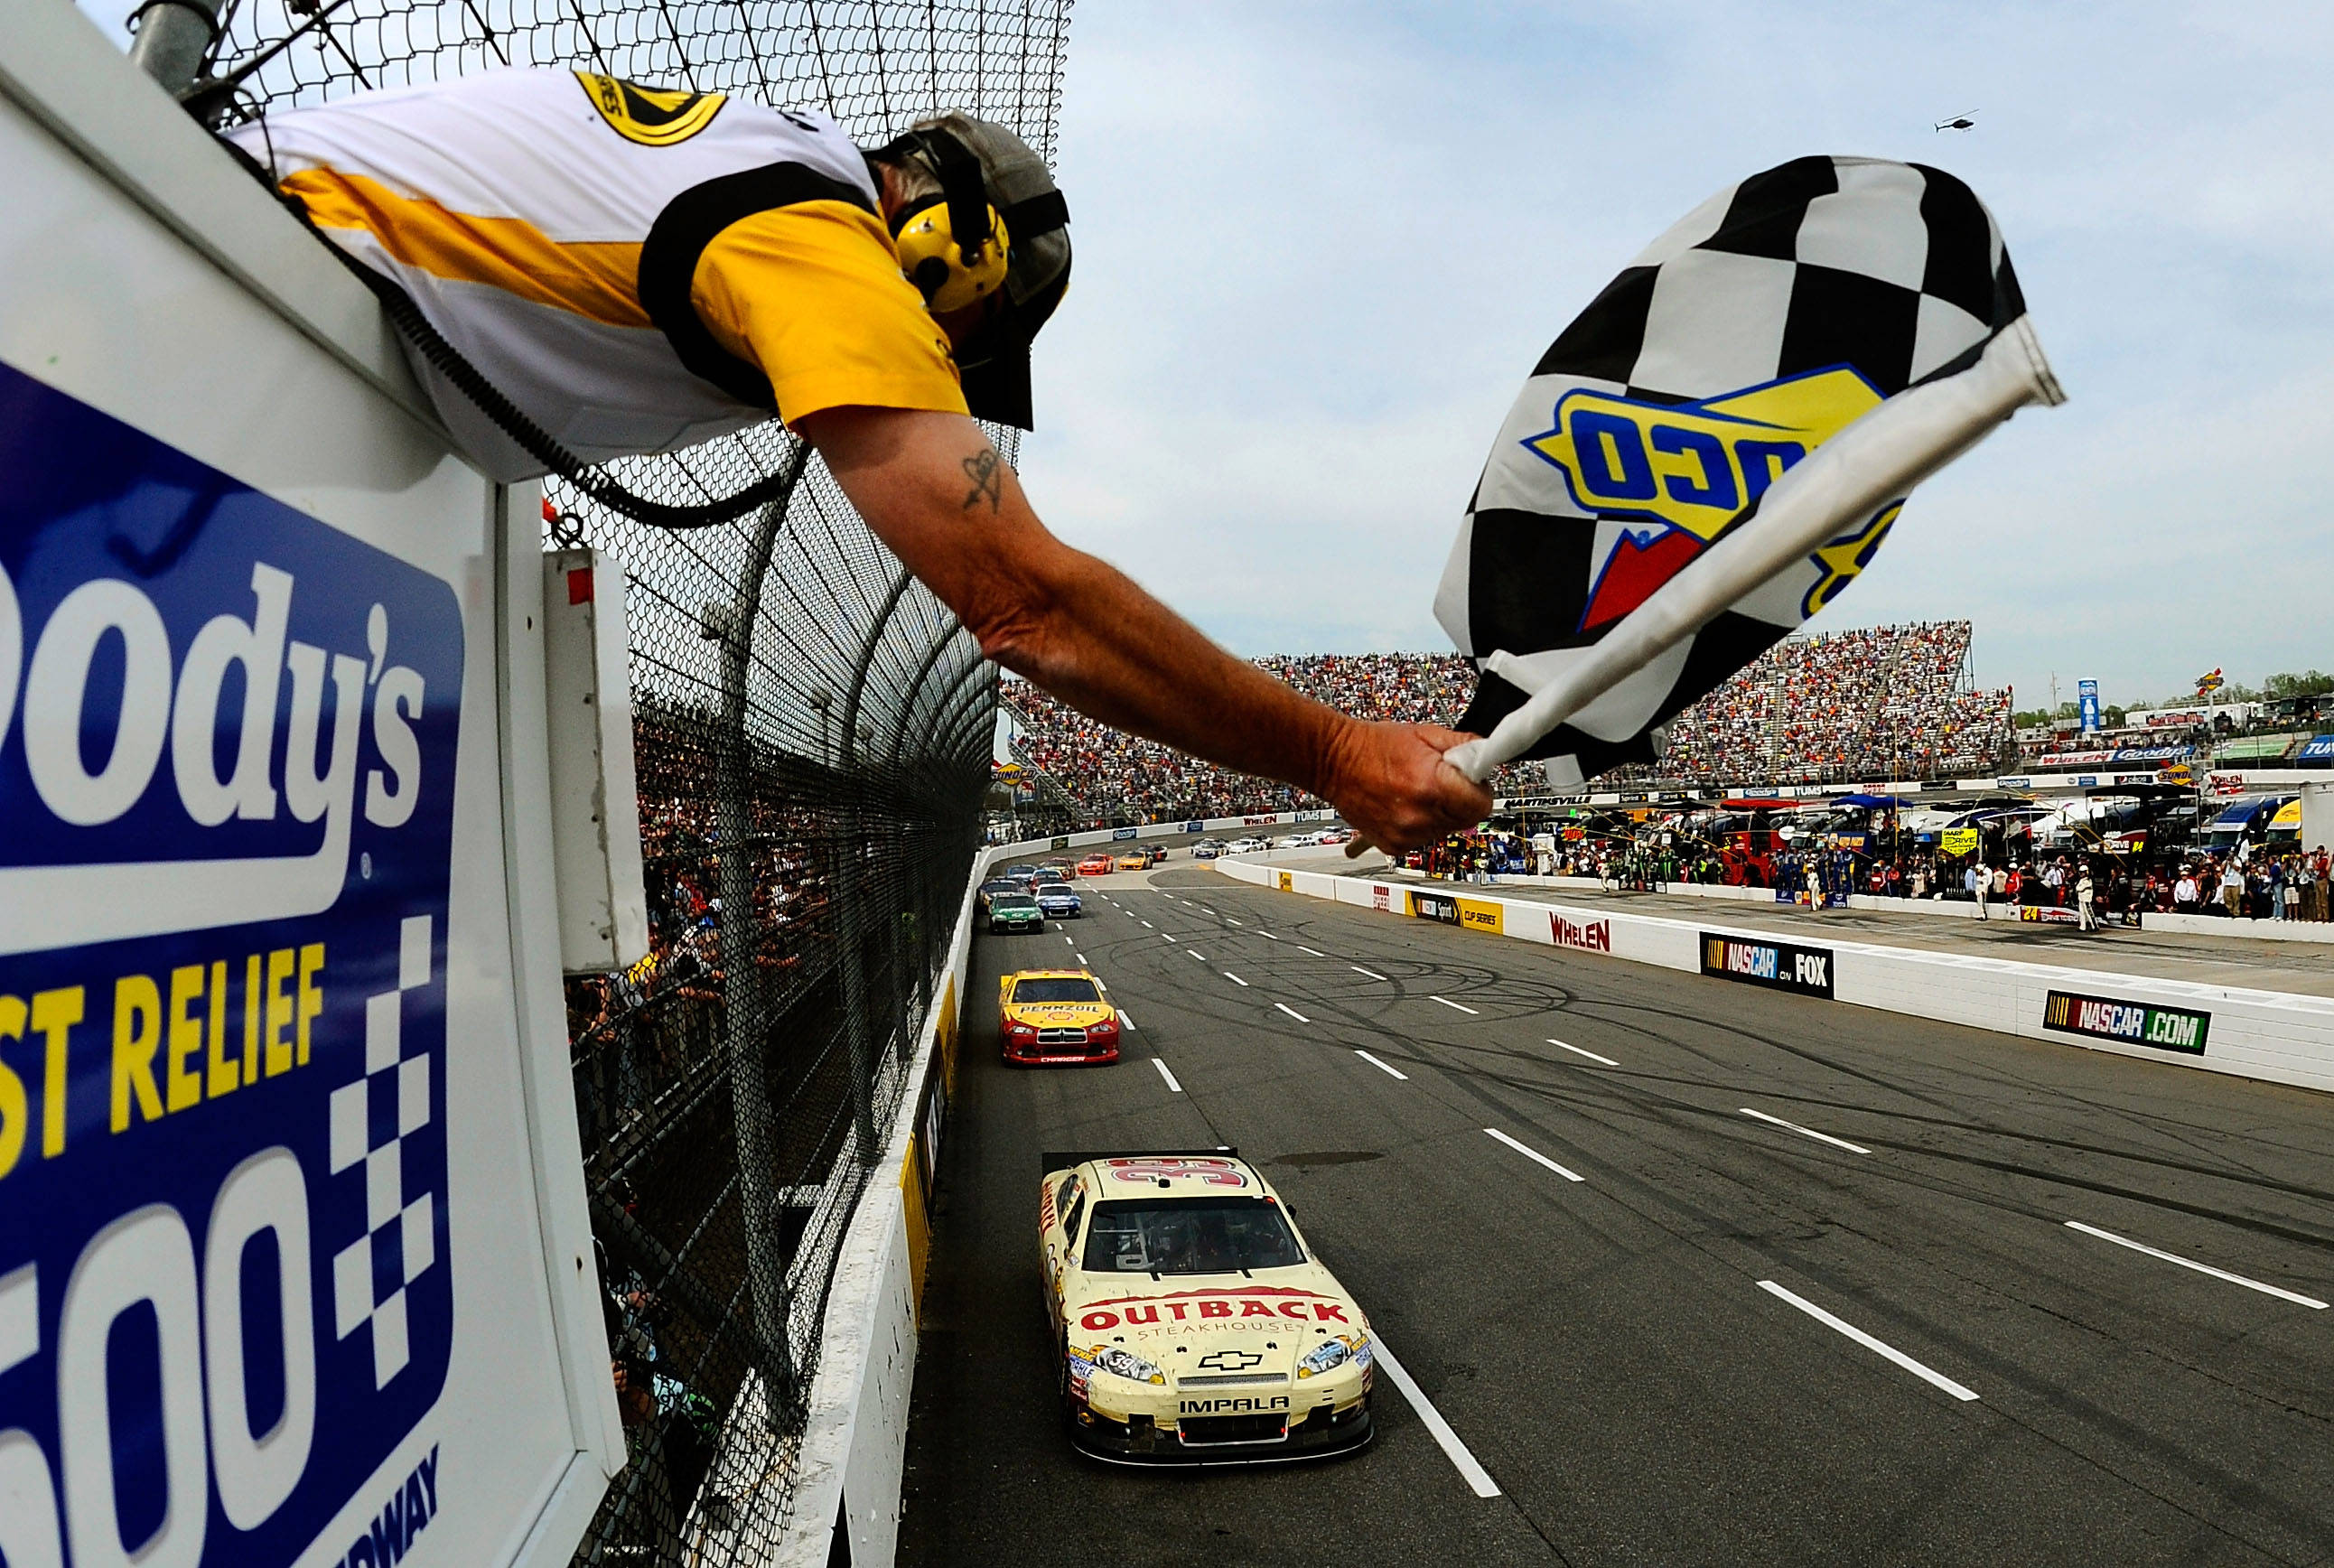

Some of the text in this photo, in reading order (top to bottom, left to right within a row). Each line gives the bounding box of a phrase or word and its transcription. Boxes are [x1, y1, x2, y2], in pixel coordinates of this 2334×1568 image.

[0, 560, 425, 914] ody's
[2306, 742, 2334, 755] TUM
[2161, 770, 2193, 779] SUNO
[1795, 786, 1823, 796] TUMS
[1243, 815, 1277, 826] WHELEN
[1296, 812, 1321, 822] TUMS
[2023, 906, 2039, 920] 24
[1548, 910, 1610, 952] WHELEN
[1727, 943, 1776, 979] NASCAR
[1795, 953, 1827, 987] FOX
[1020, 1004, 1099, 1013] PENNZOIL
[0, 942, 326, 1180] ST RELIEF
[1080, 1300, 1349, 1330] OUTBACK
[1137, 1322, 1295, 1341] STEAKHOUSE
[1108, 1354, 1135, 1370] 39
[1179, 1395, 1291, 1414] IMPALA
